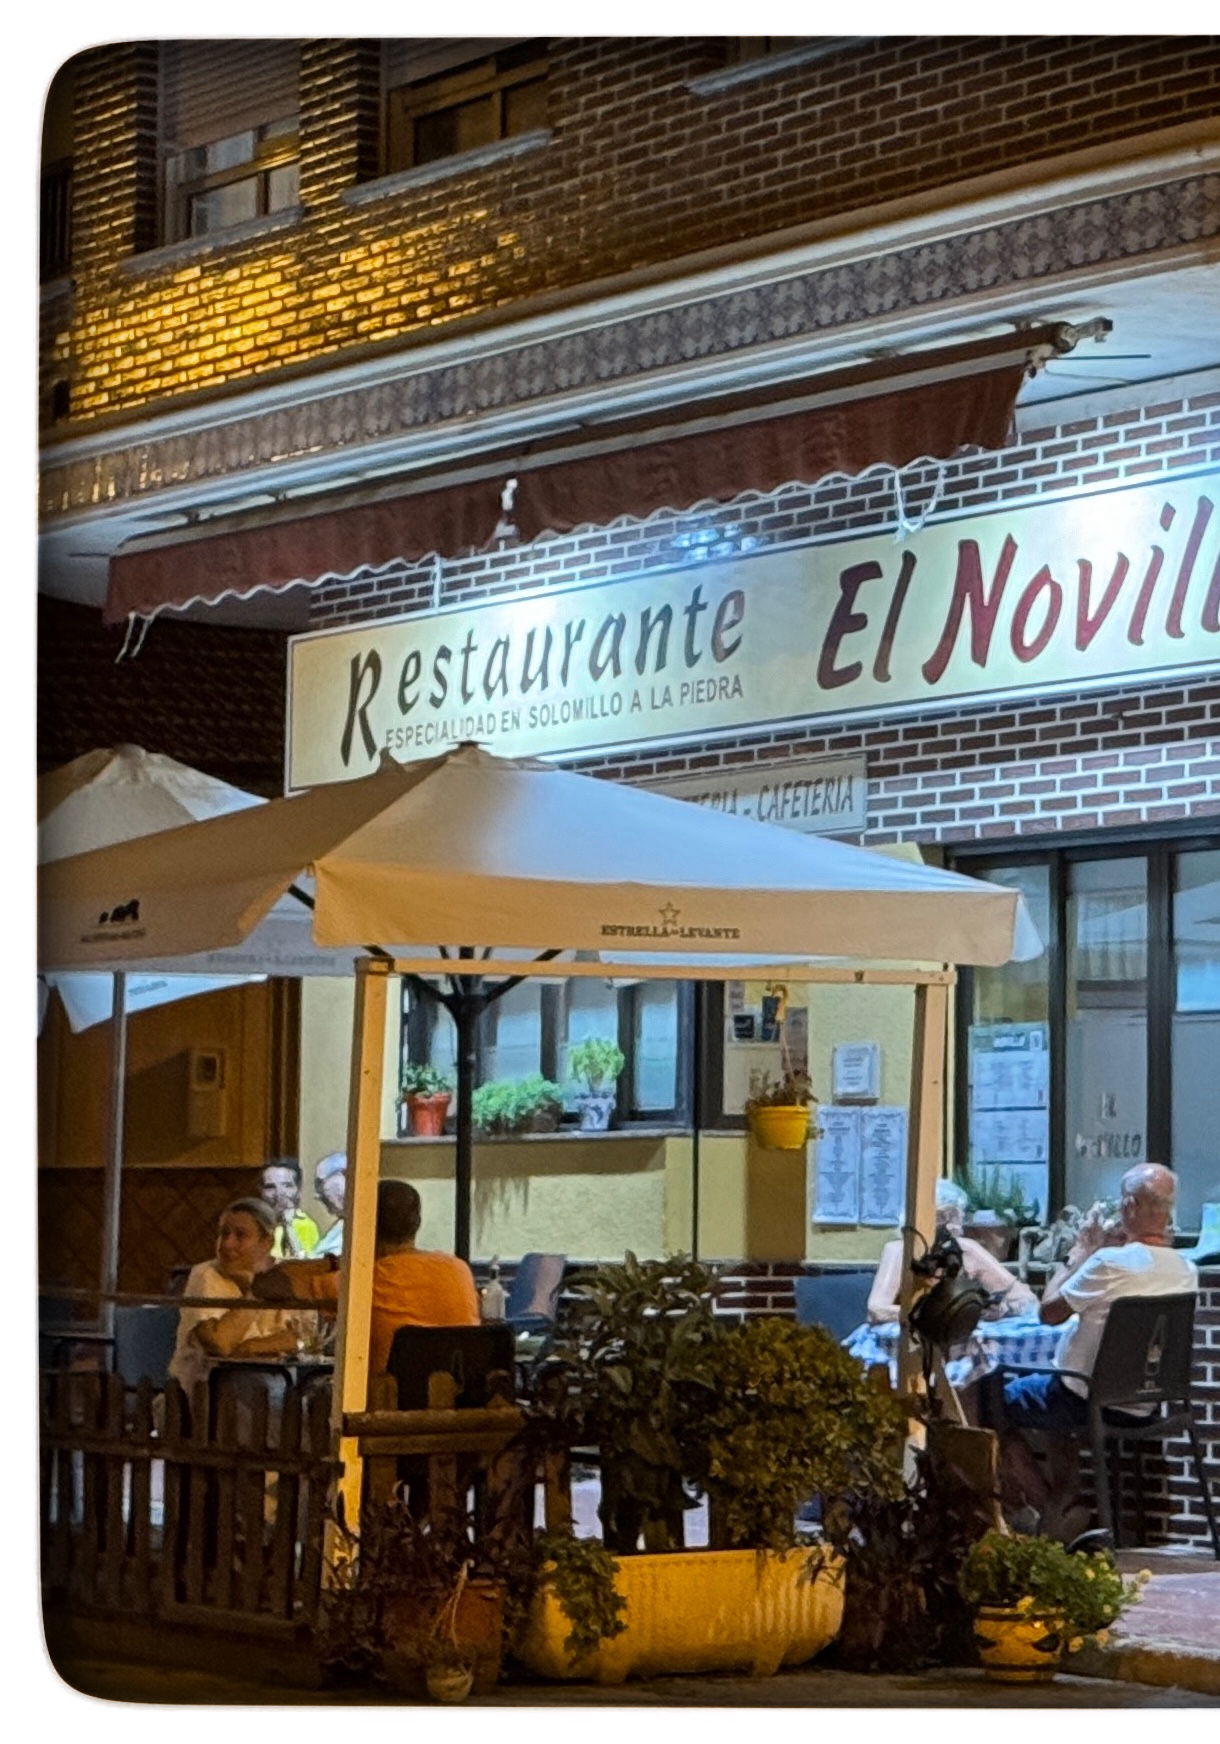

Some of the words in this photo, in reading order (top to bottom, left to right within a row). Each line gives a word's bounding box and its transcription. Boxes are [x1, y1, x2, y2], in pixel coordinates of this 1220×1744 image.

[340, 583, 746, 767] Restaurante
[817, 549, 917, 690] El
[386, 717, 496, 750] ESPECIALIDAD
[502, 711, 521, 732] EN
[529, 694, 622, 729] SOLOMILLO
[630, 690, 642, 712] A
[650, 684, 673, 709] LA
[680, 674, 744, 706] PIEDRA
[757, 774, 854, 823] CAFETERIA
[601, 924, 670, 938] ESTRELLA
[680, 926, 741, 939] LEVANTE
